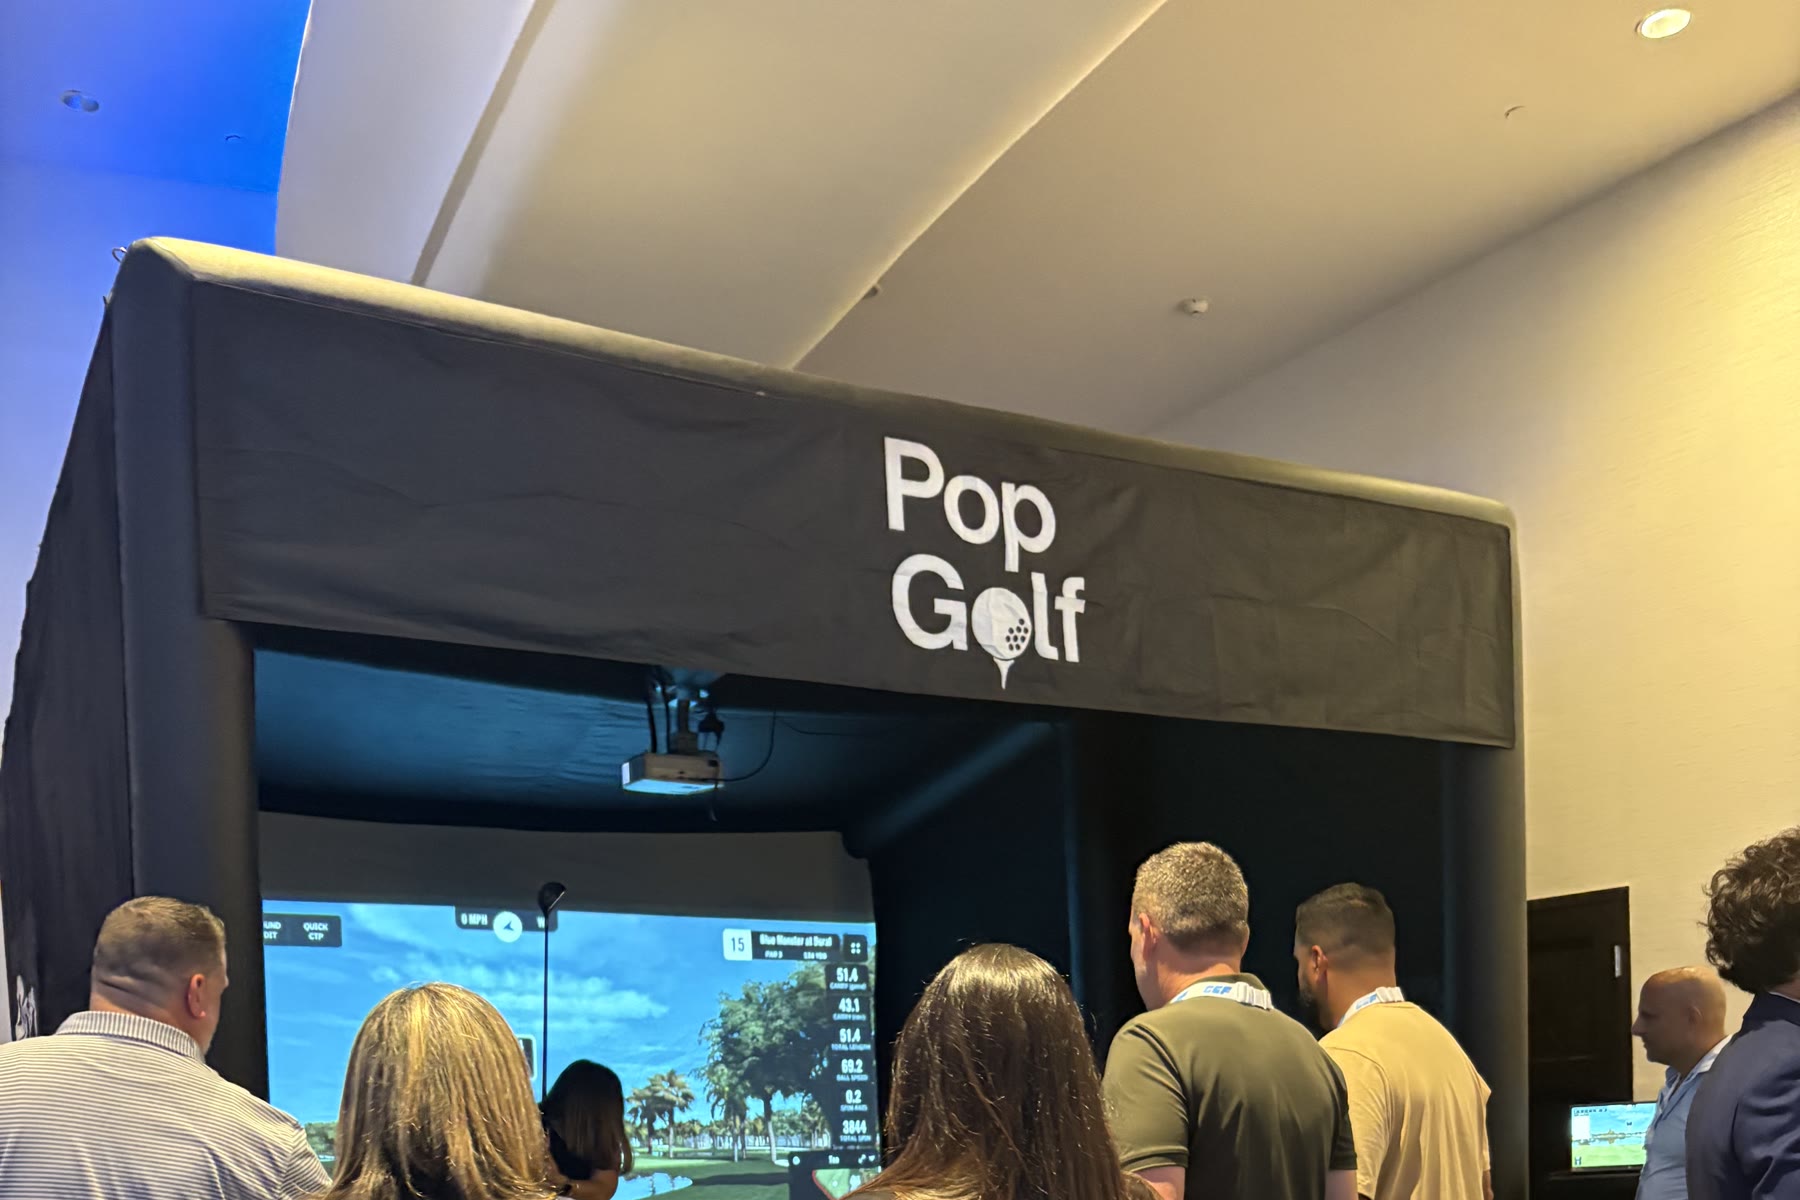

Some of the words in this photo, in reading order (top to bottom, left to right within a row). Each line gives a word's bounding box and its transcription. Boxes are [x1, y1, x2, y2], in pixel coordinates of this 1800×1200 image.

[884, 436, 1056, 573] Pop
[892, 553, 1086, 689] Golf
[303, 922, 329, 932] QUICK
[468, 913, 488, 926] MPH
[308, 932, 324, 940] CTP
[731, 937, 745, 952] 15
[836, 967, 858, 982] 51.4
[838, 998, 860, 1013] 43.1
[839, 1028, 861, 1043] 51.4
[841, 1058, 863, 1074] 69.2
[845, 1089, 862, 1104] 0.2
[842, 1120, 867, 1135] 3844
